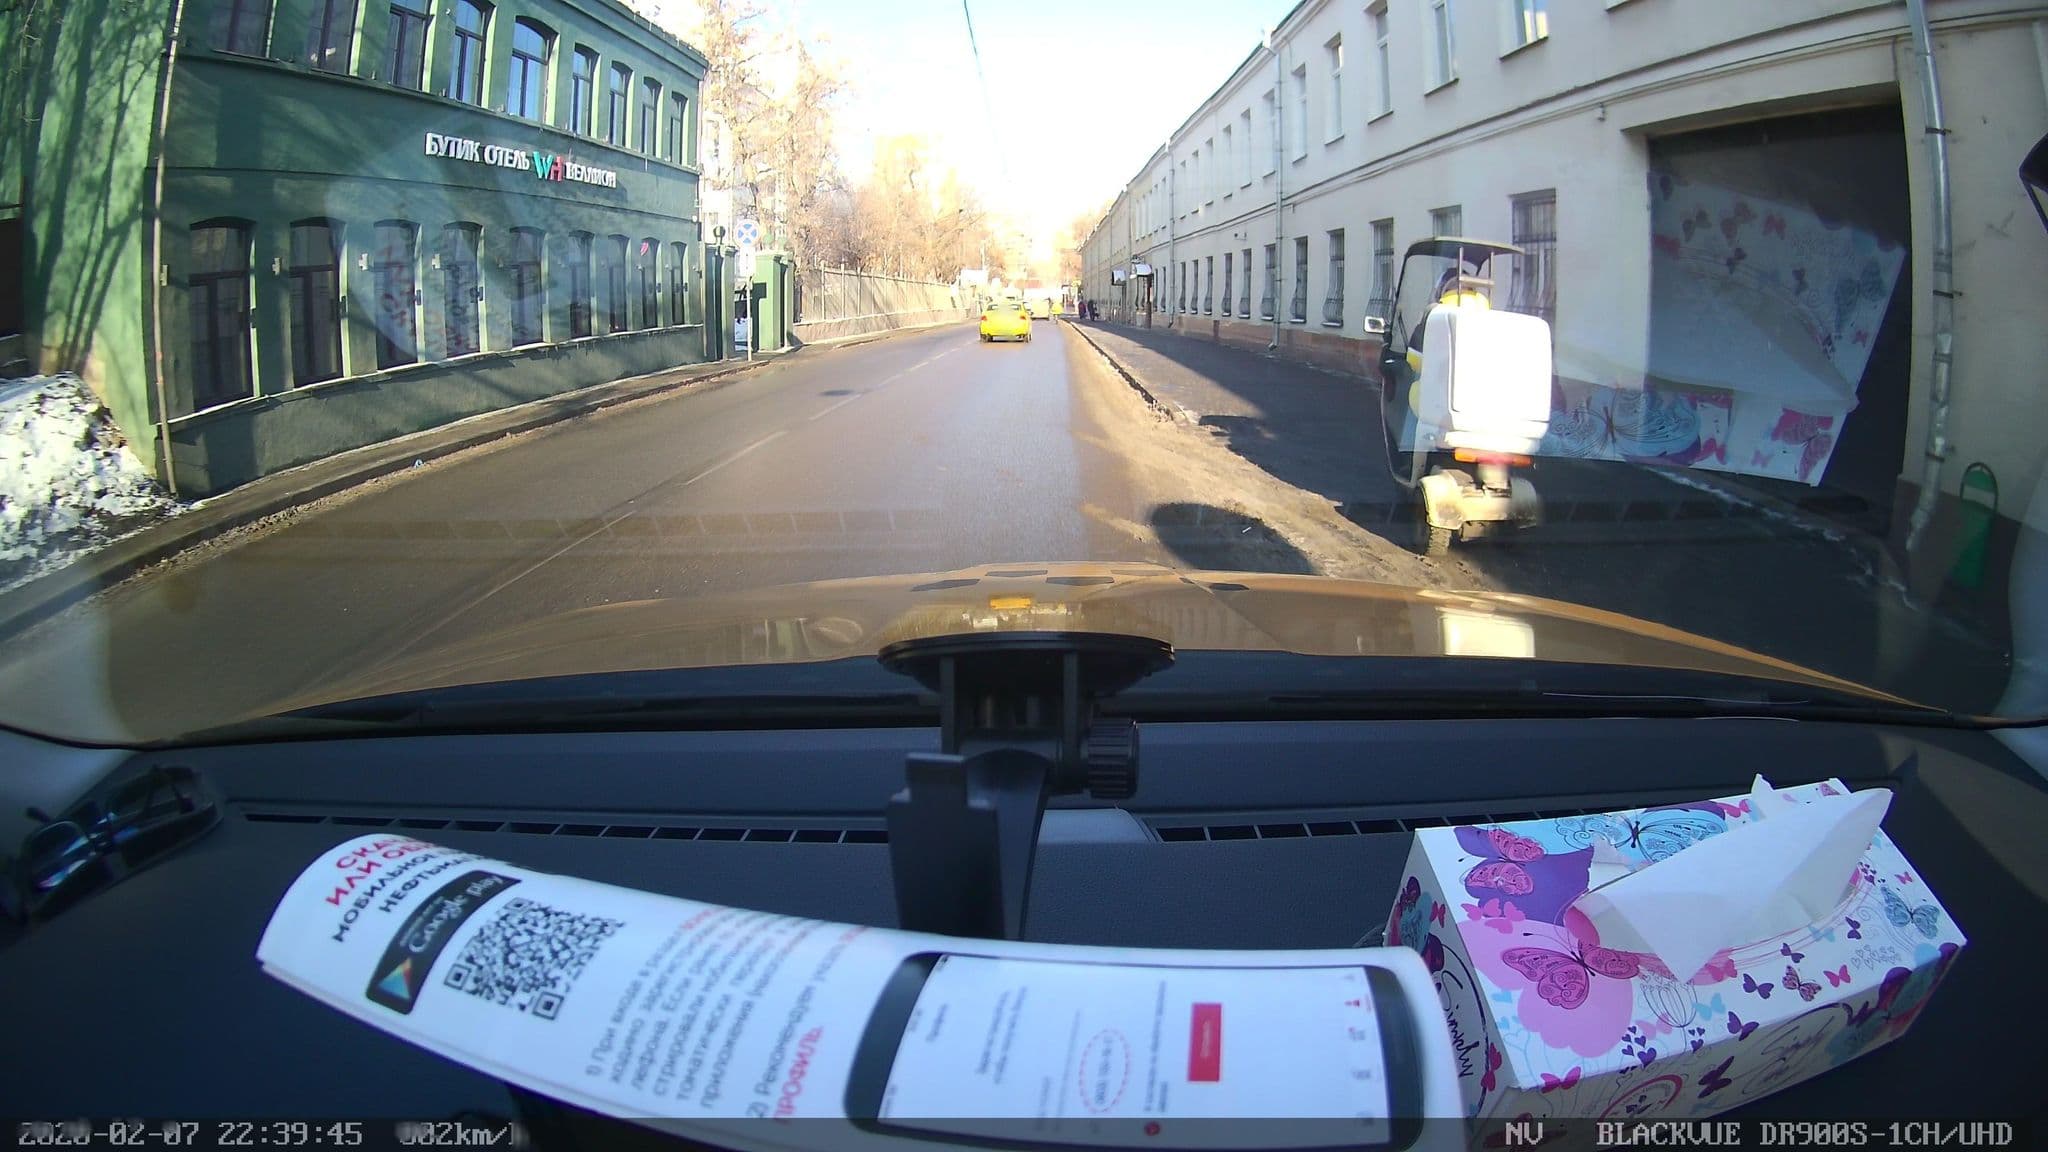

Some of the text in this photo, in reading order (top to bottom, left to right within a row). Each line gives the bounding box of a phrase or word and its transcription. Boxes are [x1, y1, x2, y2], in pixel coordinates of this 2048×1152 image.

[425, 132, 481, 163] БУТИК
[484, 145, 530, 170] ОТЕЛЬ
[326, 860, 383, 906] ИЛИ
[408, 894, 469, 953] Google
